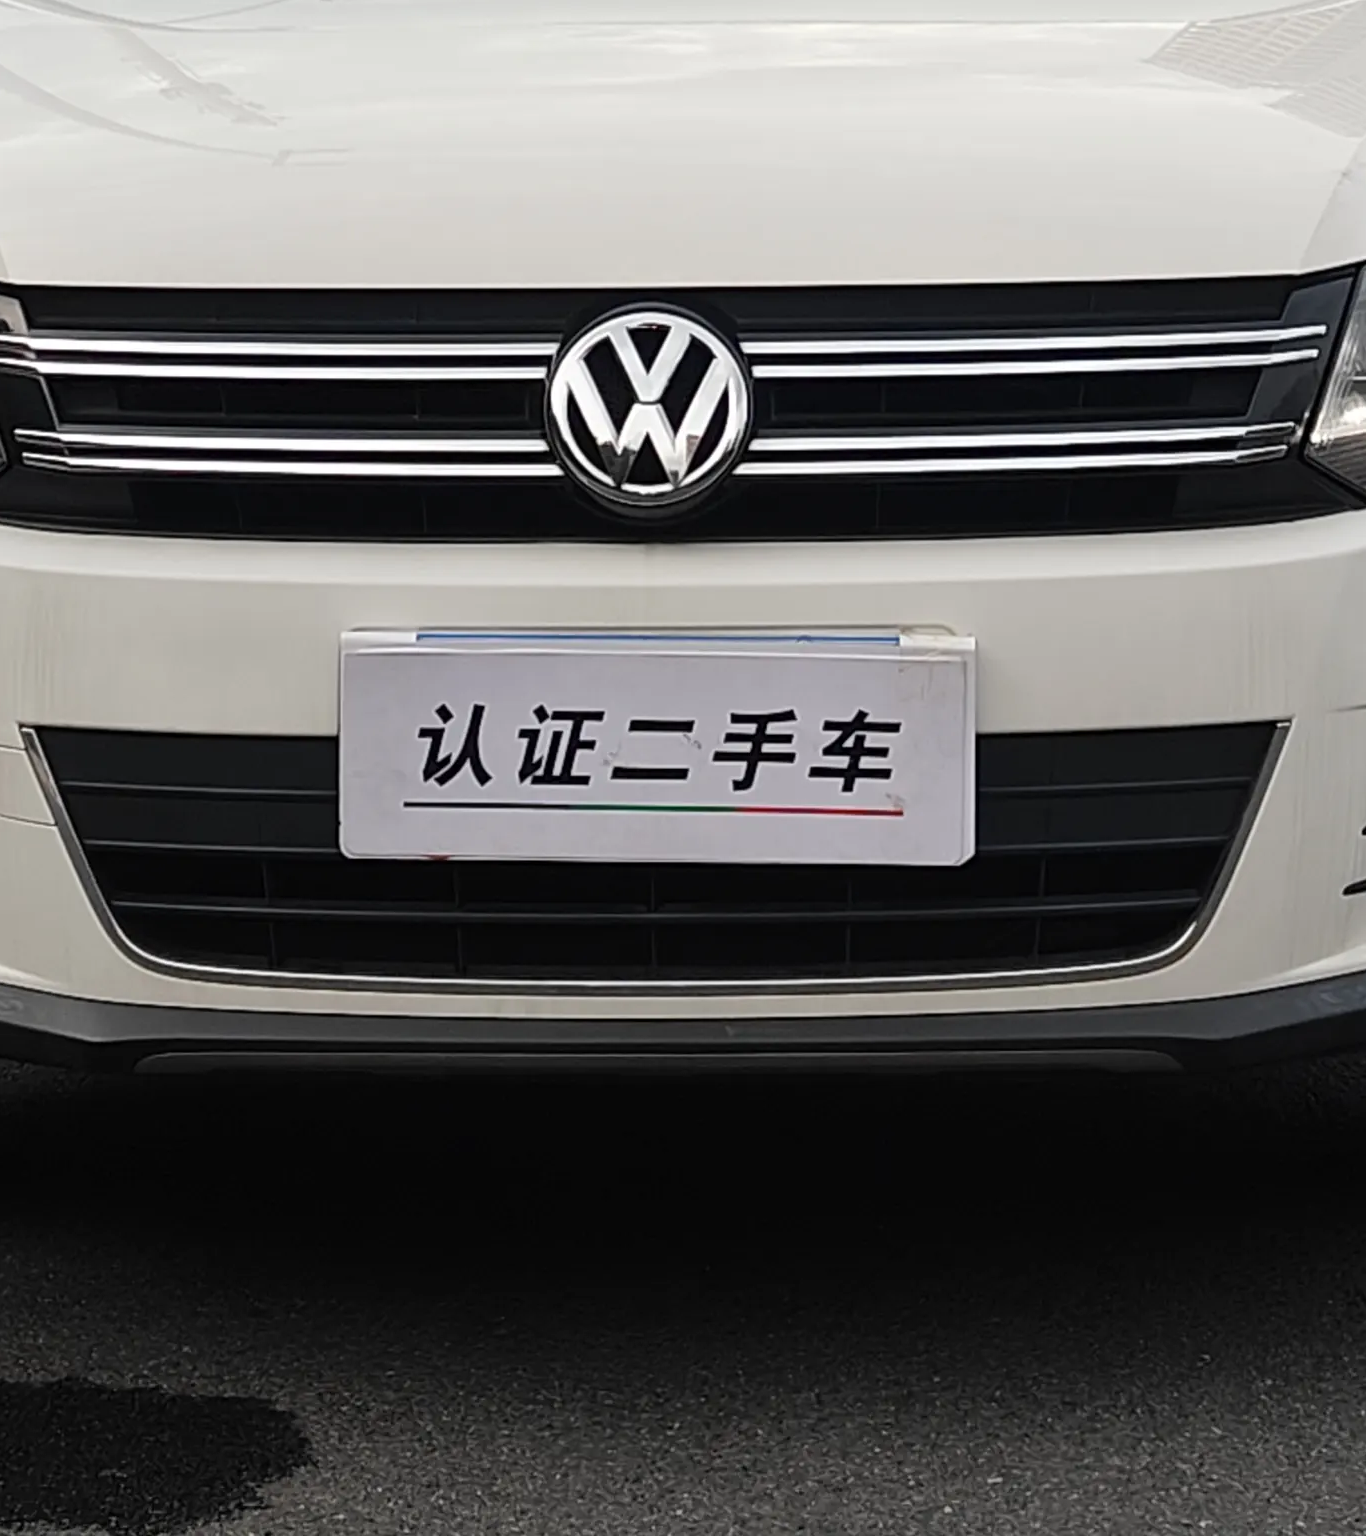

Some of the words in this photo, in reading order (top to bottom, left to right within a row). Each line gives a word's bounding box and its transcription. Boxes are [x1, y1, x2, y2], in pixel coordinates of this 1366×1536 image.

[553, 313, 745, 493] VW
[416, 703, 902, 793] 认证二手车
